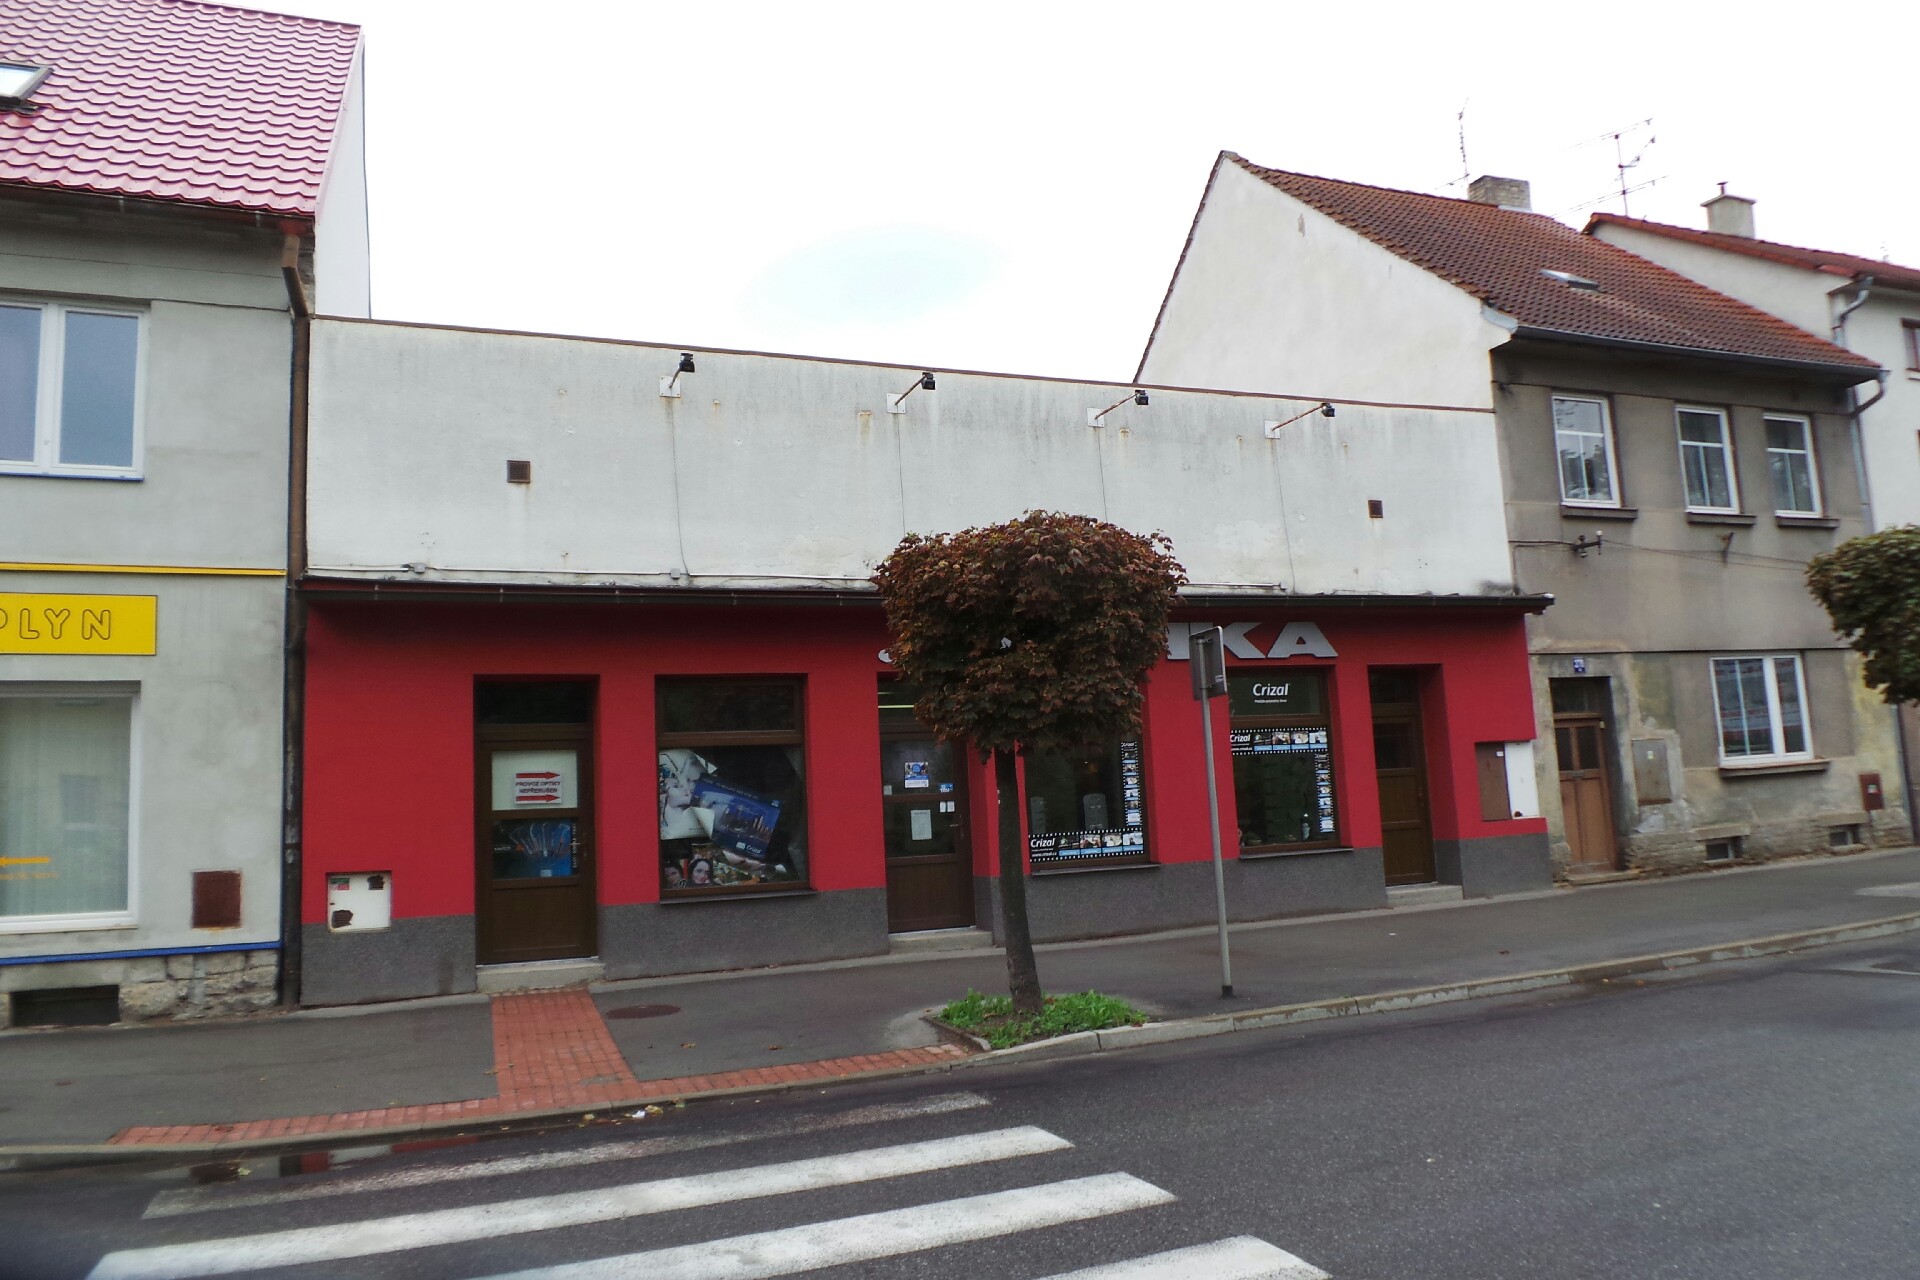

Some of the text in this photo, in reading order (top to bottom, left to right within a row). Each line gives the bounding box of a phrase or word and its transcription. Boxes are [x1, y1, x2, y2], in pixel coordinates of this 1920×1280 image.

[1252, 682, 1289, 696] Crizal
[1230, 734, 1251, 743] Crizal
[1030, 837, 1056, 848] Crizal
